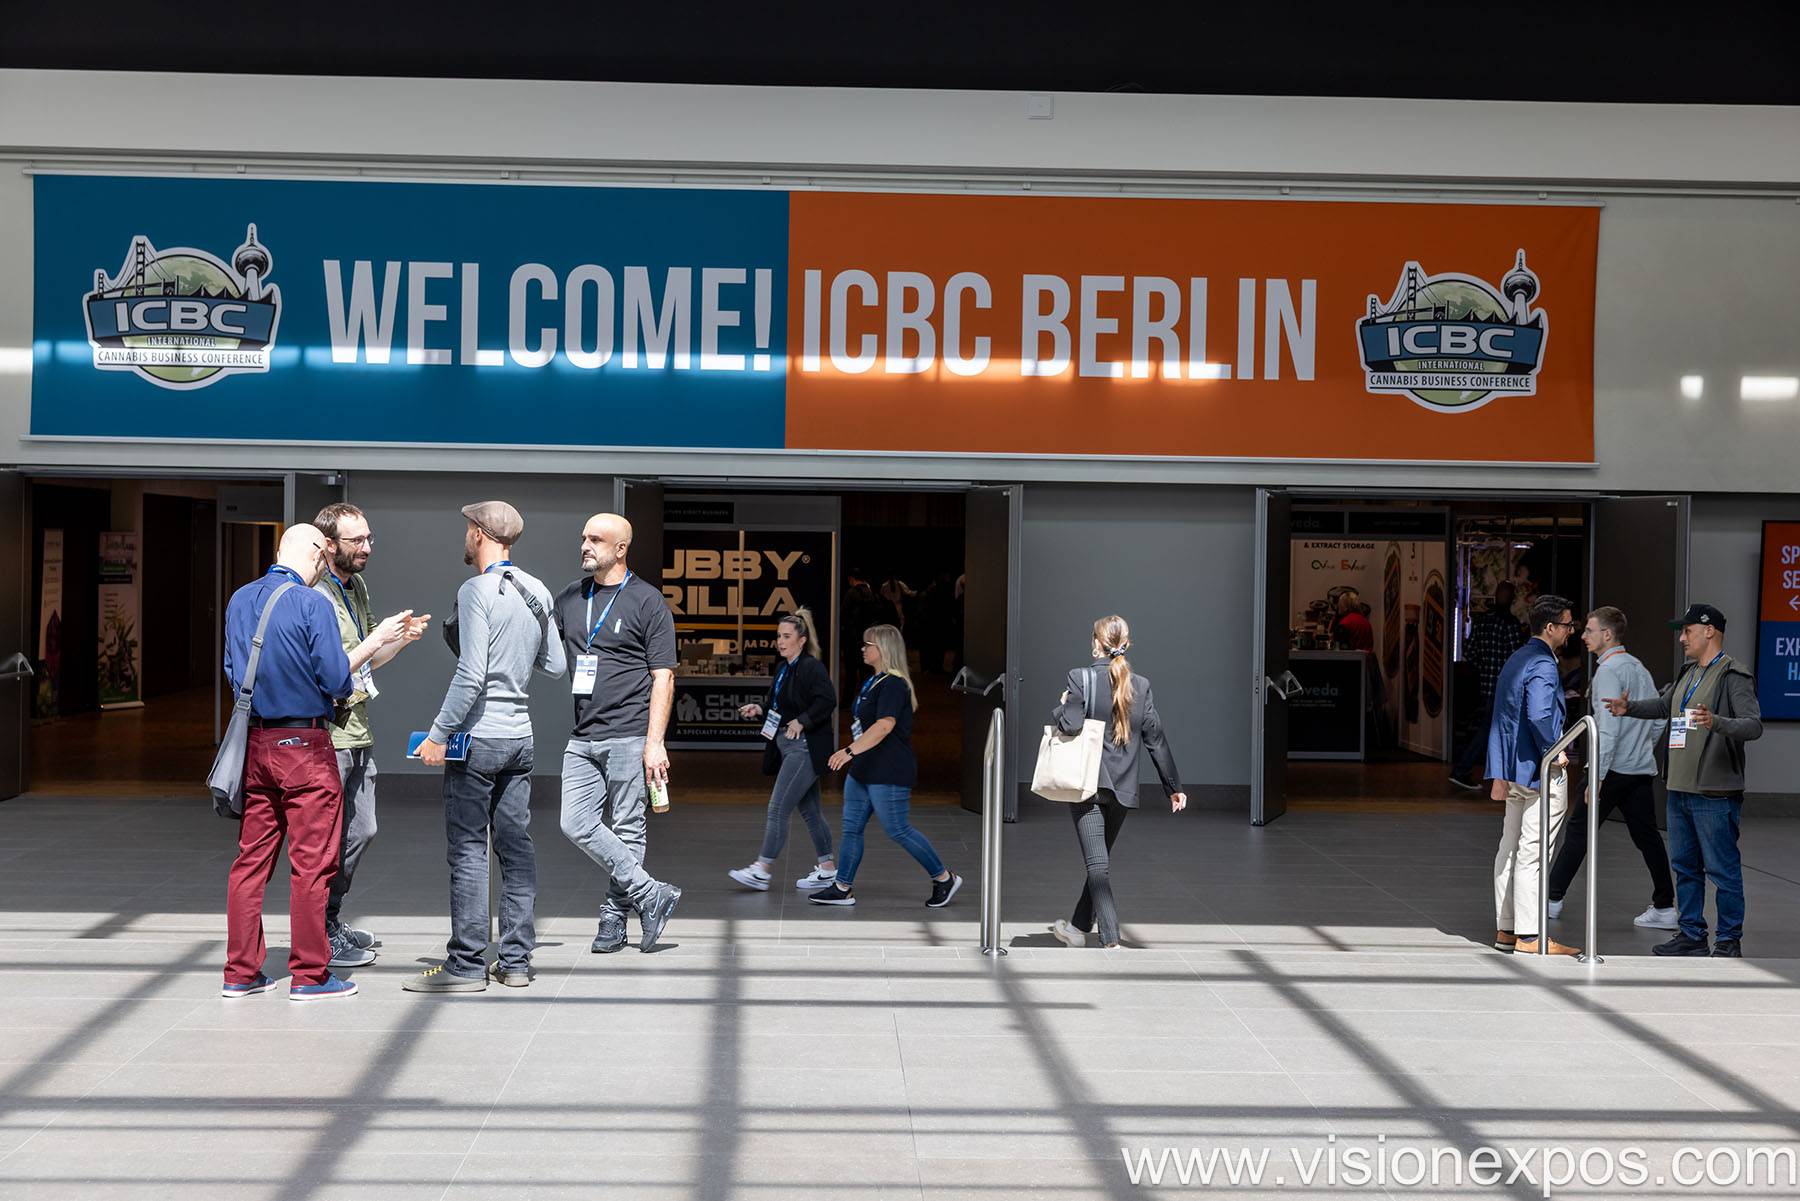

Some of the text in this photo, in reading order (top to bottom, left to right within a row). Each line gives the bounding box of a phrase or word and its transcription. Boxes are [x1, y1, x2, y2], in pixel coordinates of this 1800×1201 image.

[116, 300, 247, 334] ICBC
[323, 259, 773, 373] WELCOME!
[802, 268, 1317, 382] ICBC BERLIN
[147, 336, 216, 347] INTERNATIONAL
[1387, 325, 1515, 358] ICBC
[98, 351, 263, 364] CANNABIS BUSINESS CONFERENCE
[1418, 361, 1485, 371] INTERNATIONAL
[1370, 375, 1530, 388] CANNABIS BUSINESS CONFERENCE
[1343, 542, 1375, 550] STORAGE
[1788, 662, 1800, 681] H
[704, 694, 768, 707] CHUB
